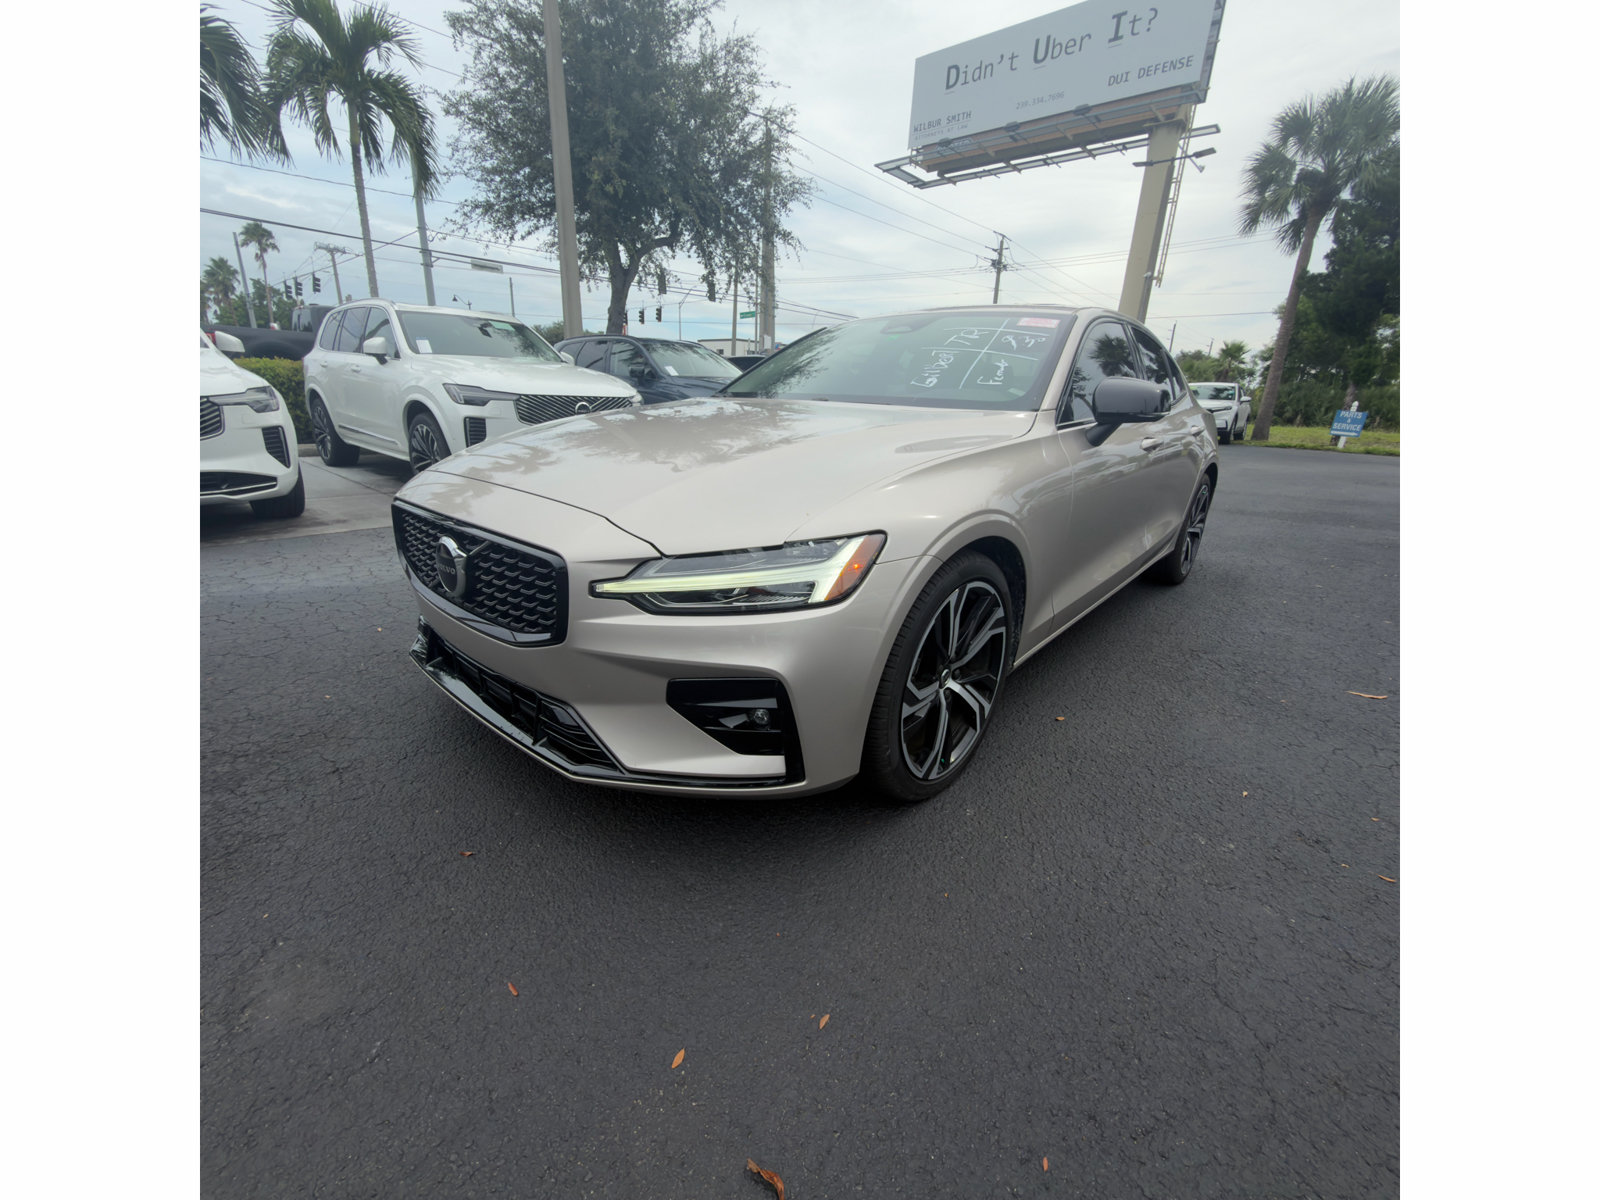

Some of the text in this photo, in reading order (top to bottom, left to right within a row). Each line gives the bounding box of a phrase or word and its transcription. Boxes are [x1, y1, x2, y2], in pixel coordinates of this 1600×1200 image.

[945, 7, 1158, 90] Didn't Uber It?
[1107, 55, 1194, 87] DUI DEFENSE
[913, 110, 973, 132] WILBUR SMITH
[1340, 410, 1363, 419] PARTS
[1332, 422, 1362, 432] SERVICE
